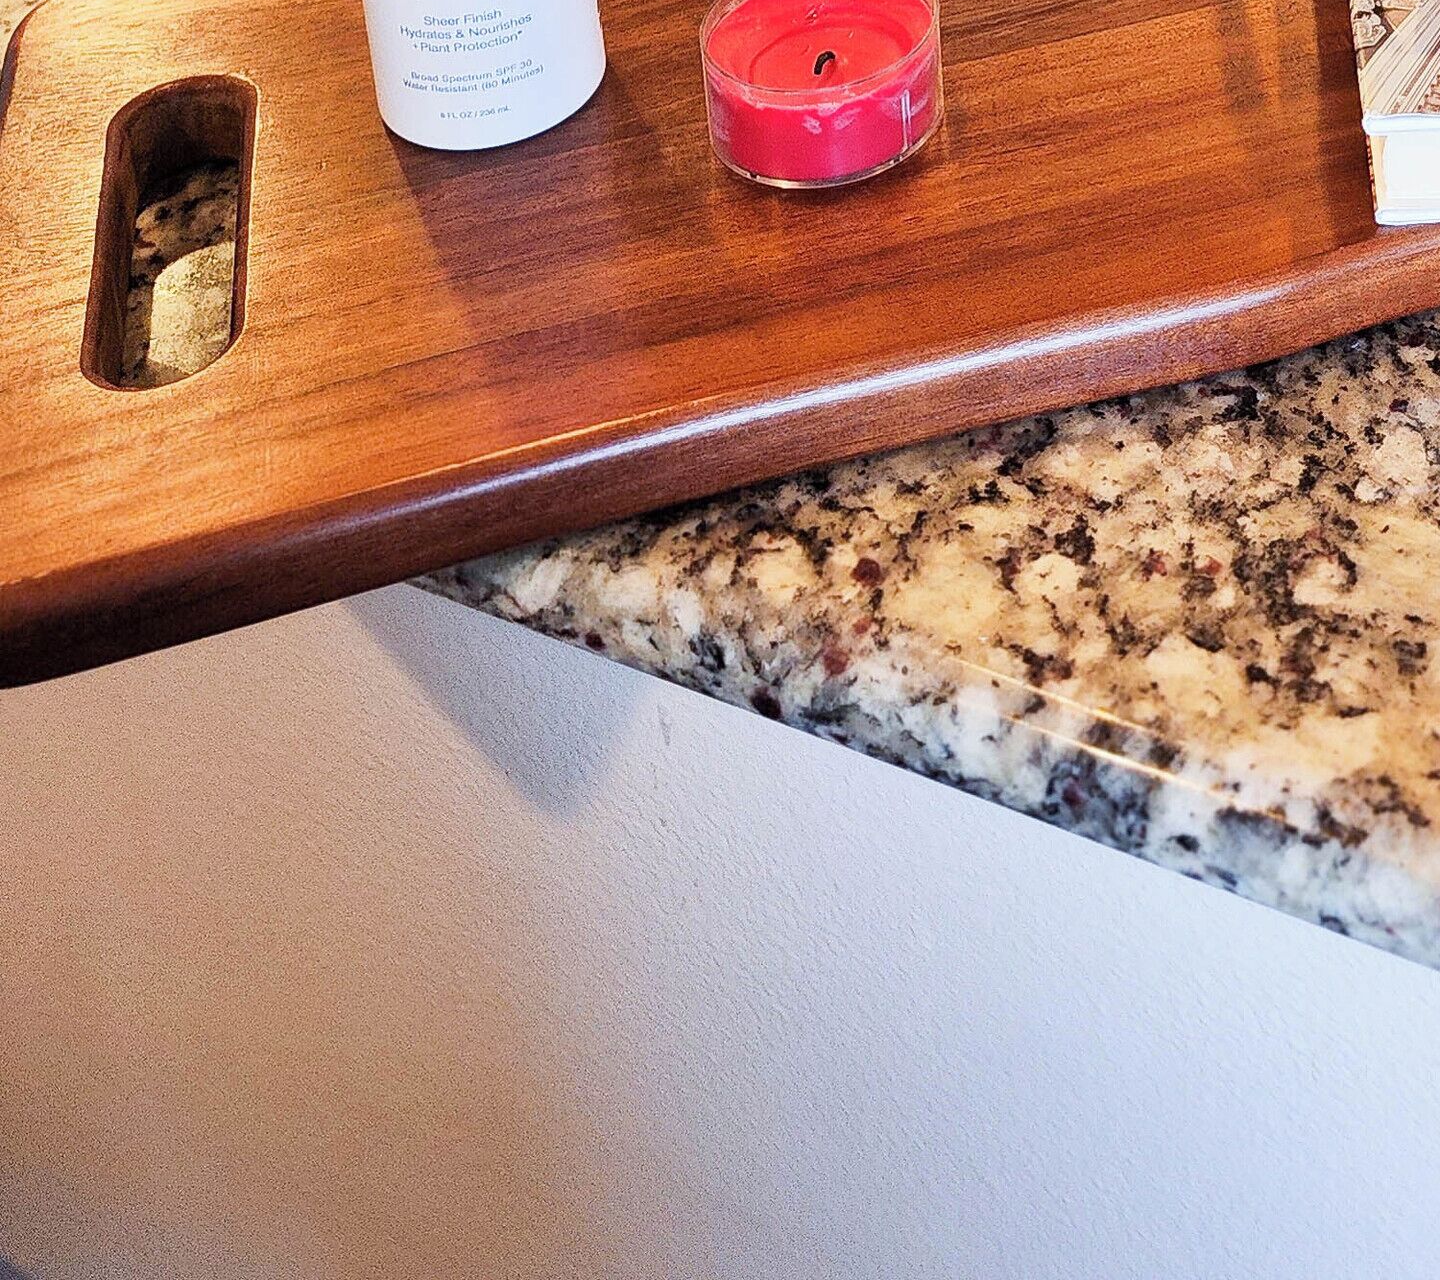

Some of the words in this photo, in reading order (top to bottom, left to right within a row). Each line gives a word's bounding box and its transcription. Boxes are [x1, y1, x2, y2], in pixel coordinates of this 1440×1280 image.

[399, 25, 452, 40] Hydrates
[455, 29, 465, 39] &
[468, 13, 532, 38] Nourishes
[423, 15, 460, 27] Sheer
[464, 9, 502, 24] Finish
[442, 72, 493, 84] Spectrum
[495, 64, 517, 77] SPF
[520, 59, 533, 70] 30
[501, 65, 545, 85] Minutes)
